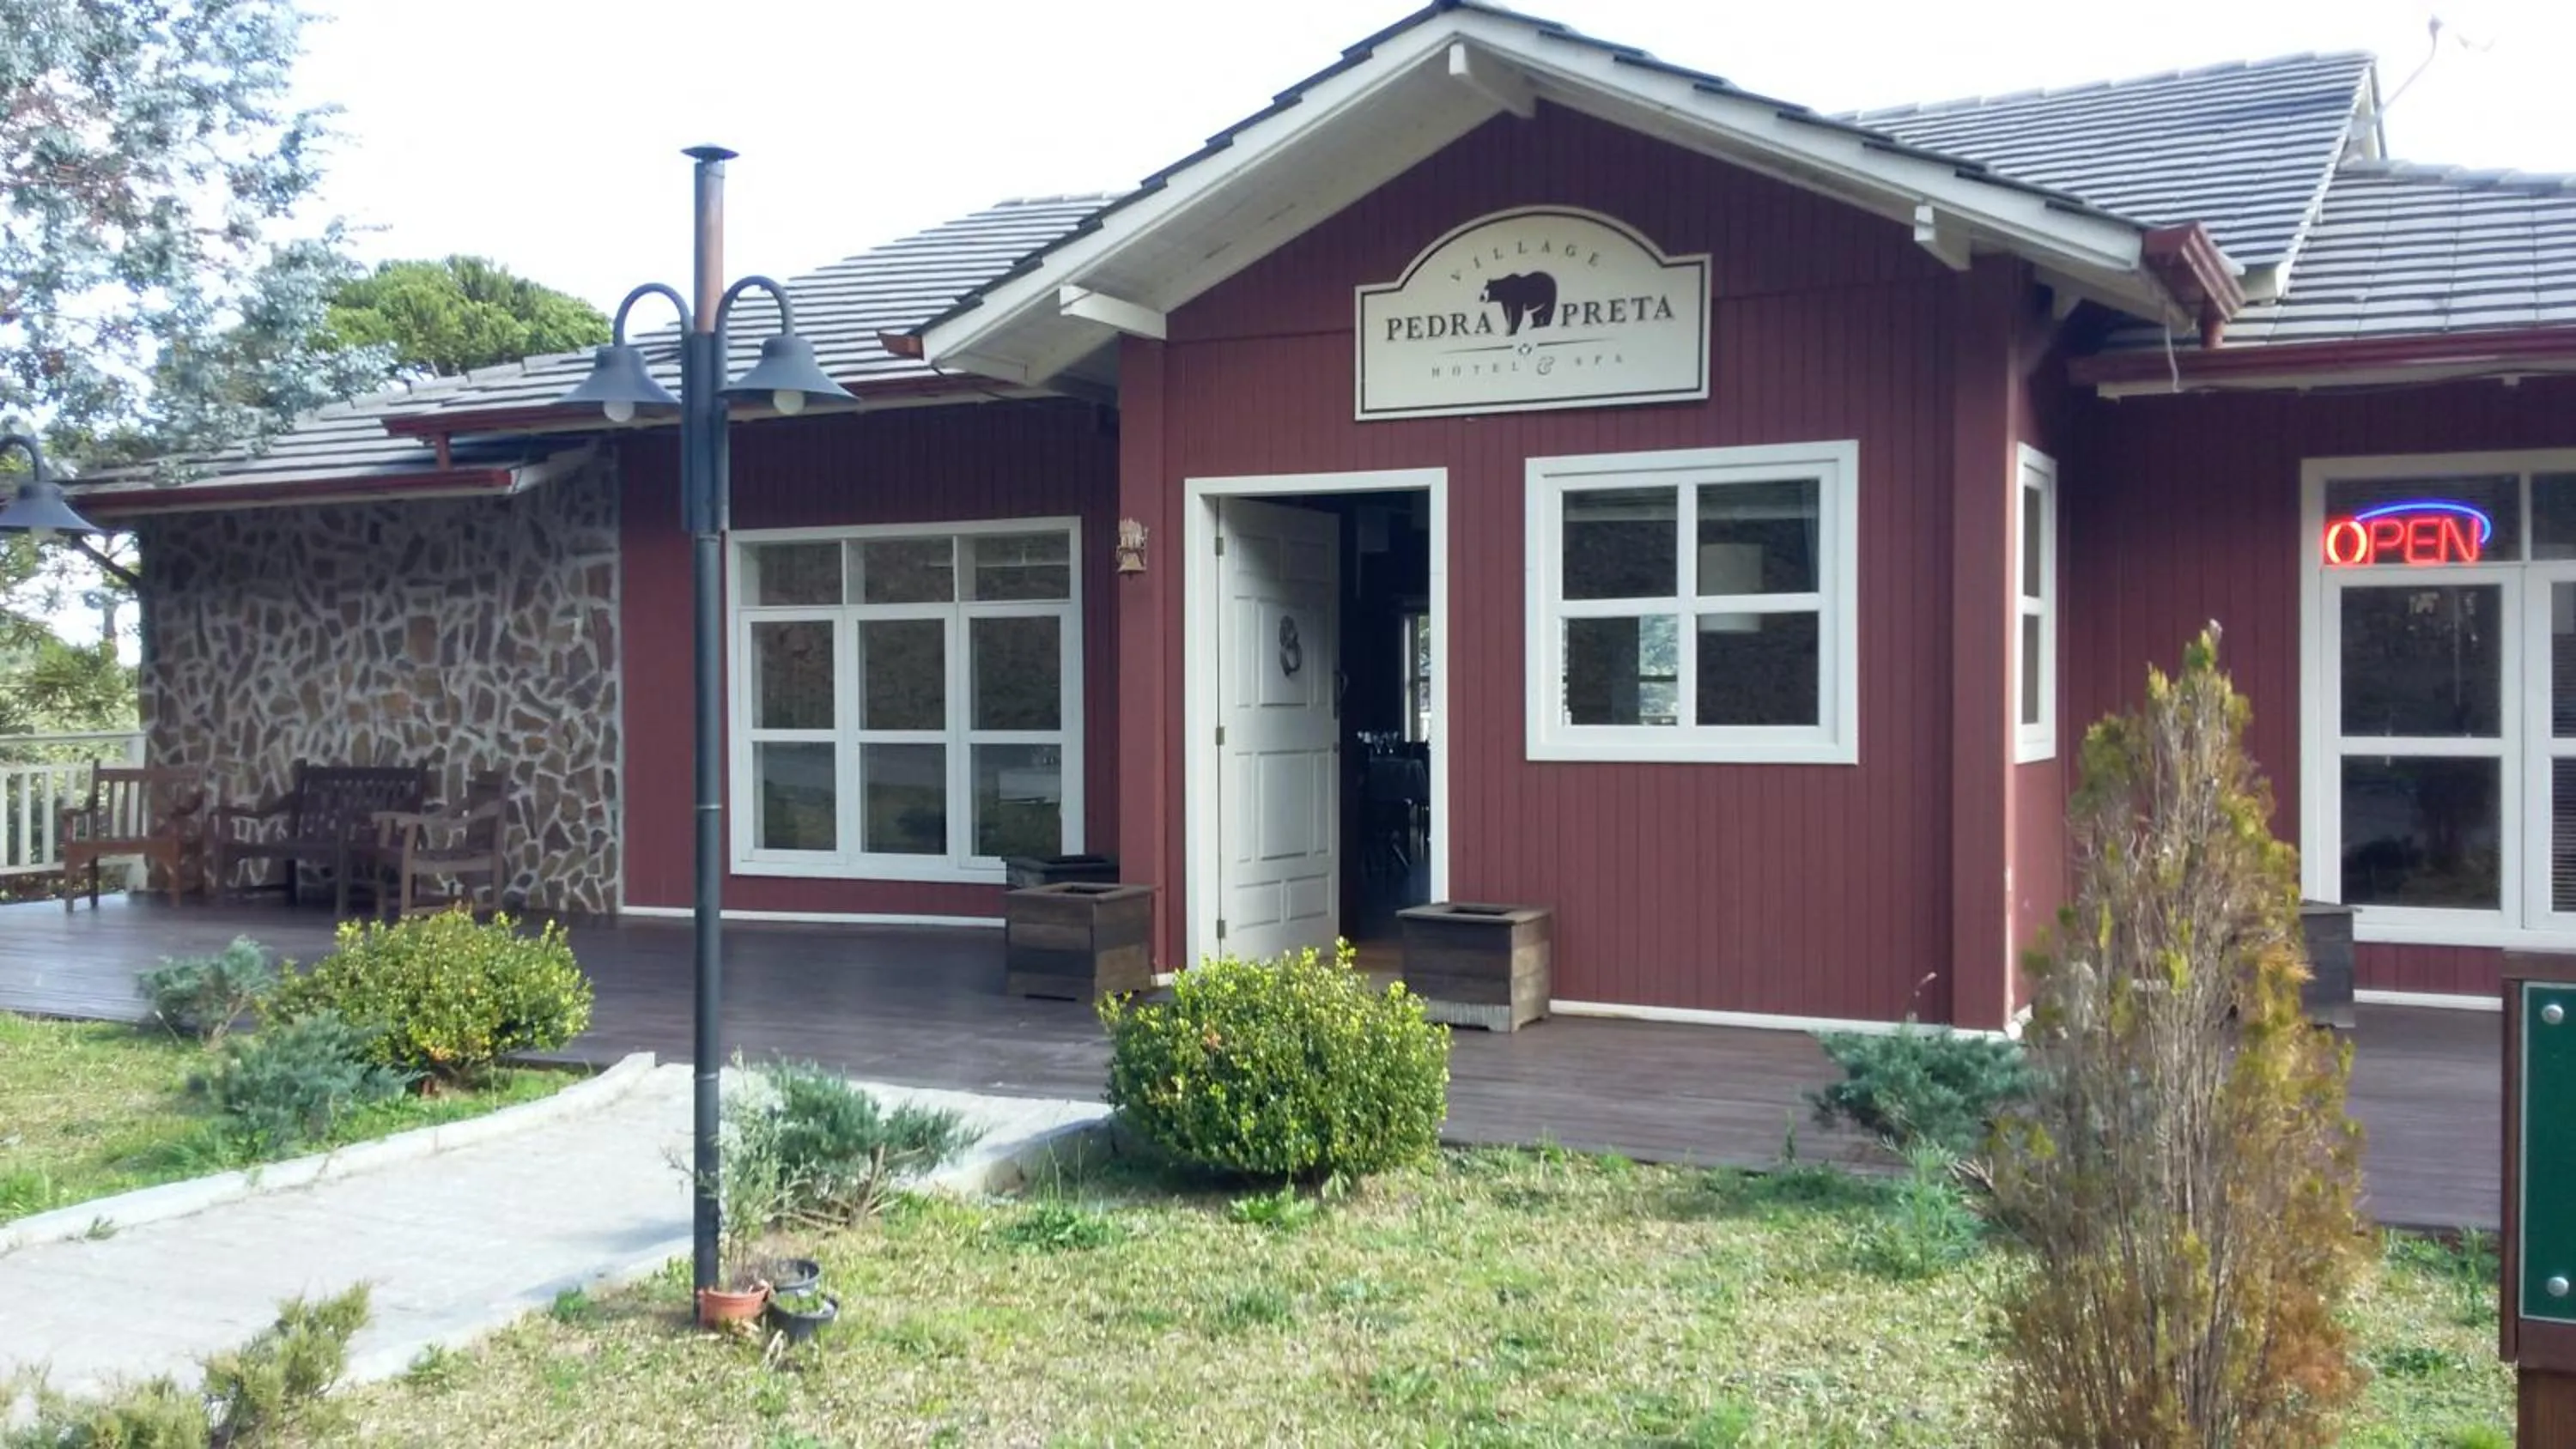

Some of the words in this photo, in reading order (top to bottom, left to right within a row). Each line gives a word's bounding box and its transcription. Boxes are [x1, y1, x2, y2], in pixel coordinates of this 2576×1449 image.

[1451, 240, 1601, 282] VILLAGE
[1386, 311, 1494, 342] PEDRA
[1561, 294, 1674, 327] PRETA
[1431, 361, 1519, 378] HOTEL
[1536, 356, 1555, 376] &
[1574, 354, 1624, 367] SPA
[2324, 518, 2480, 565] OPEN
